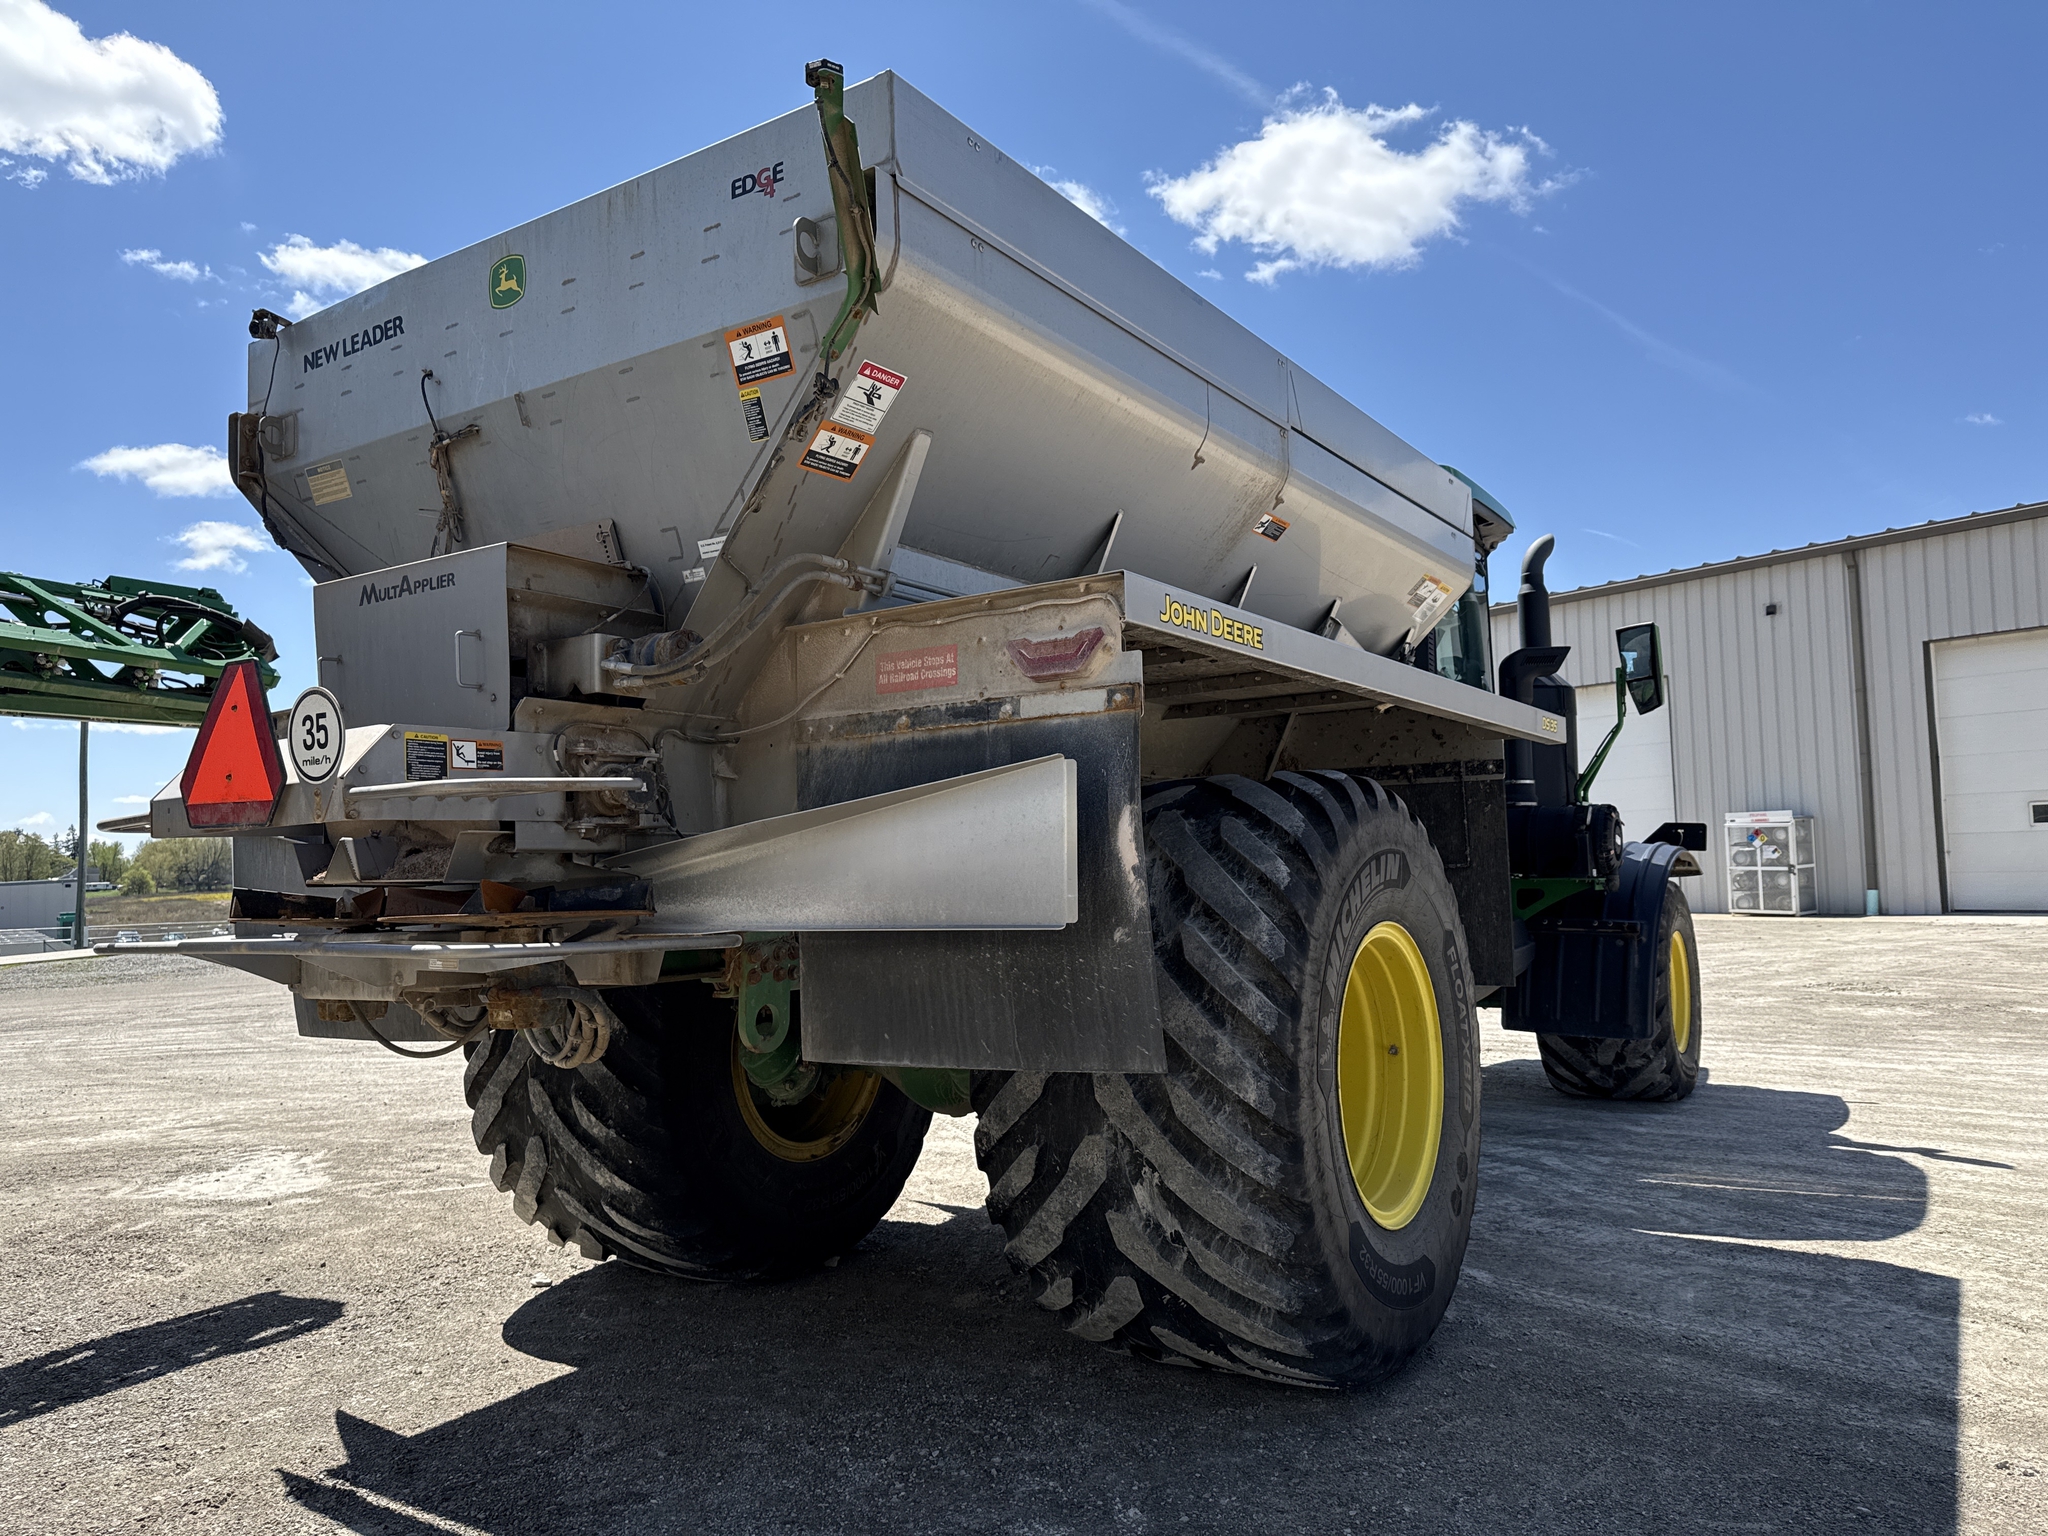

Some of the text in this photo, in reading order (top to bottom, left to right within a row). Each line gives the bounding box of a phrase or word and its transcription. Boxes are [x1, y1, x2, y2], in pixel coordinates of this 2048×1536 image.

[731, 161, 784, 200] EDGE
[742, 320, 772, 335] WARNING
[303, 315, 405, 373] NEW LEADER
[871, 369, 900, 386] DANGER
[838, 426, 866, 441] WARNING
[1160, 593, 1263, 650] JOHN DEERE
[879, 667, 956, 684] All Railroad Crossings
[880, 653, 954, 672] This Vehicle Stops At
[302, 712, 328, 751] 35
[302, 755, 331, 766] mile/h
[1326, 853, 1400, 1002] MICHELIN
[1447, 945, 1472, 1114] FLOATXBIB
